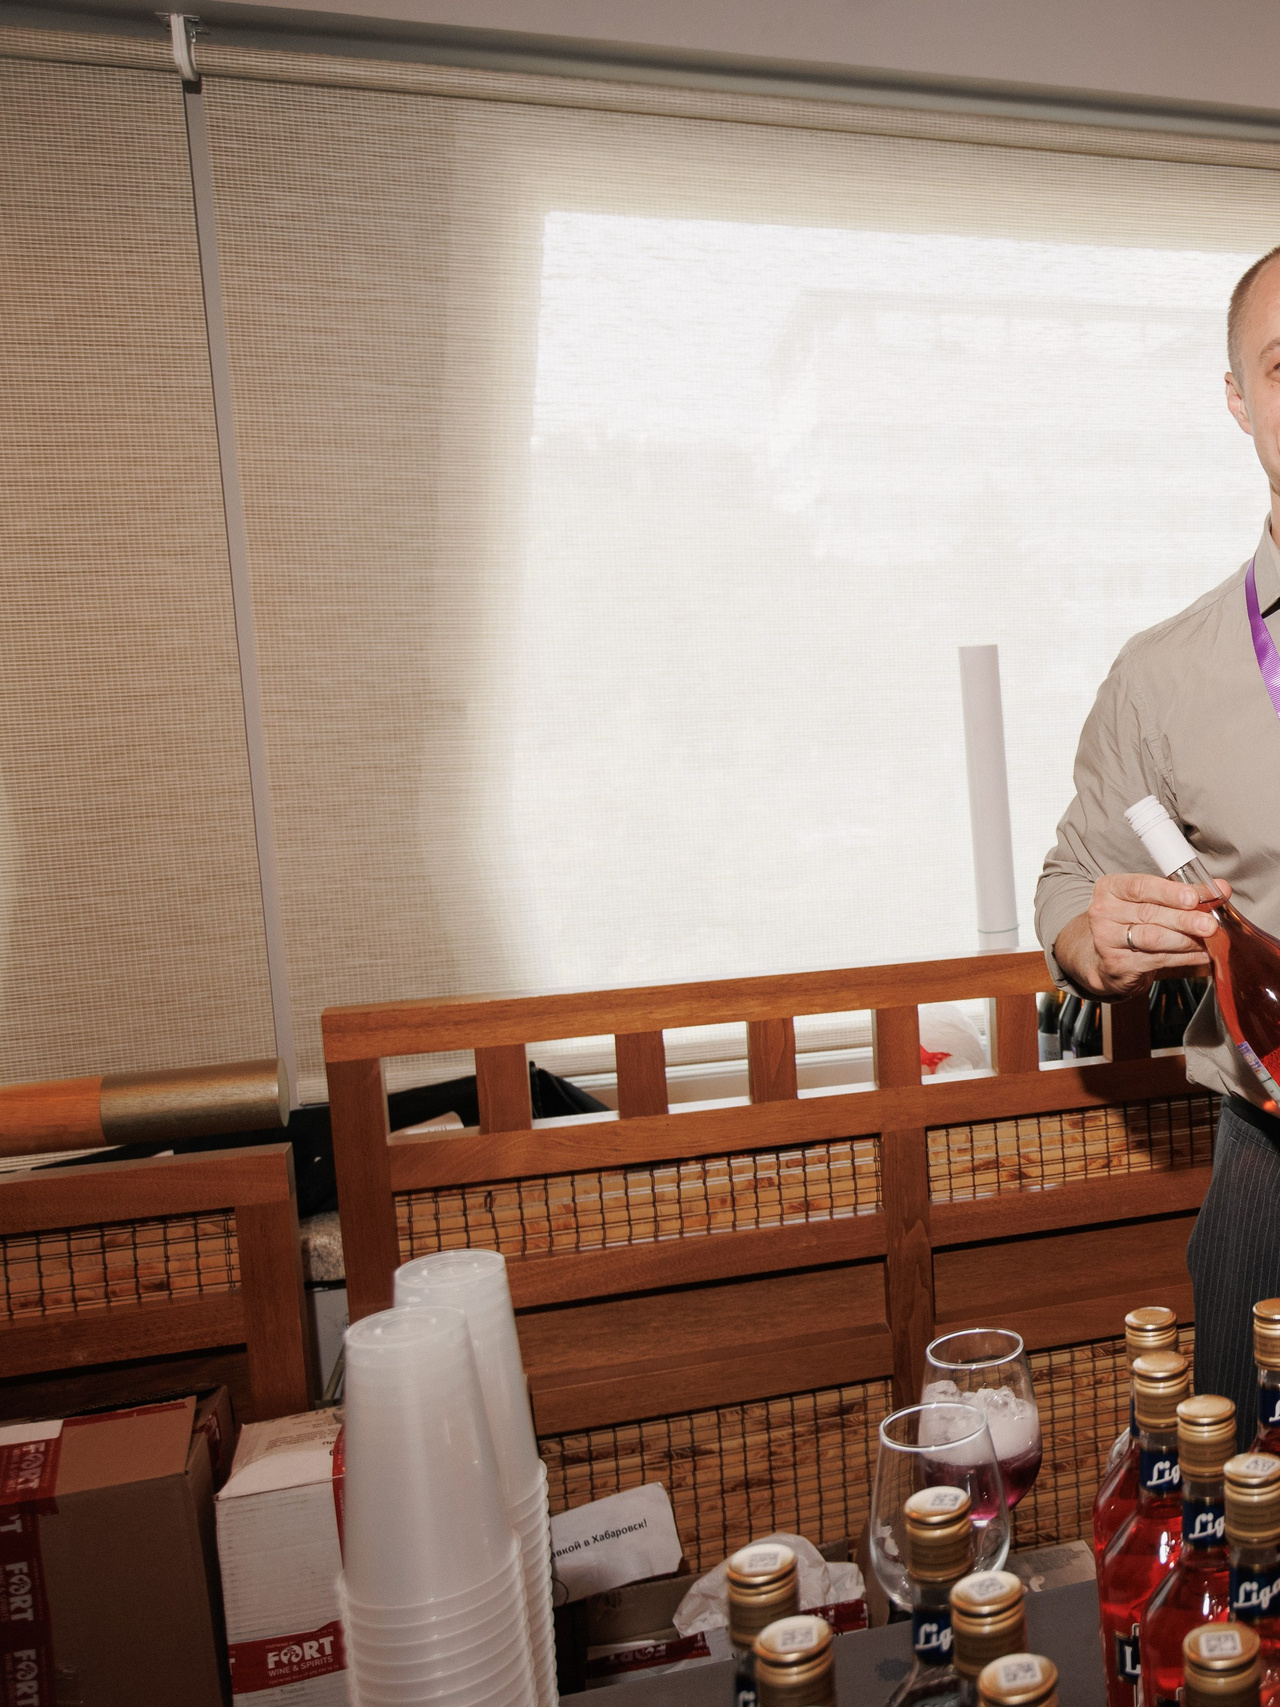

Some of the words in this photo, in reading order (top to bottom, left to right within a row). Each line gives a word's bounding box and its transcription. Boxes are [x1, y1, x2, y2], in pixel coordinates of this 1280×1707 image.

[17, 1442, 46, 1490] FORT
[592, 1518, 648, 1544] Хабаровск!
[4, 1561, 34, 1622] FORT
[267, 1635, 335, 1670] FORT
[268, 1666, 291, 1678] WINE
[292, 1664, 299, 1672] &
[300, 1655, 334, 1671] SPIRITS
[13, 1648, 40, 1707] FORT
